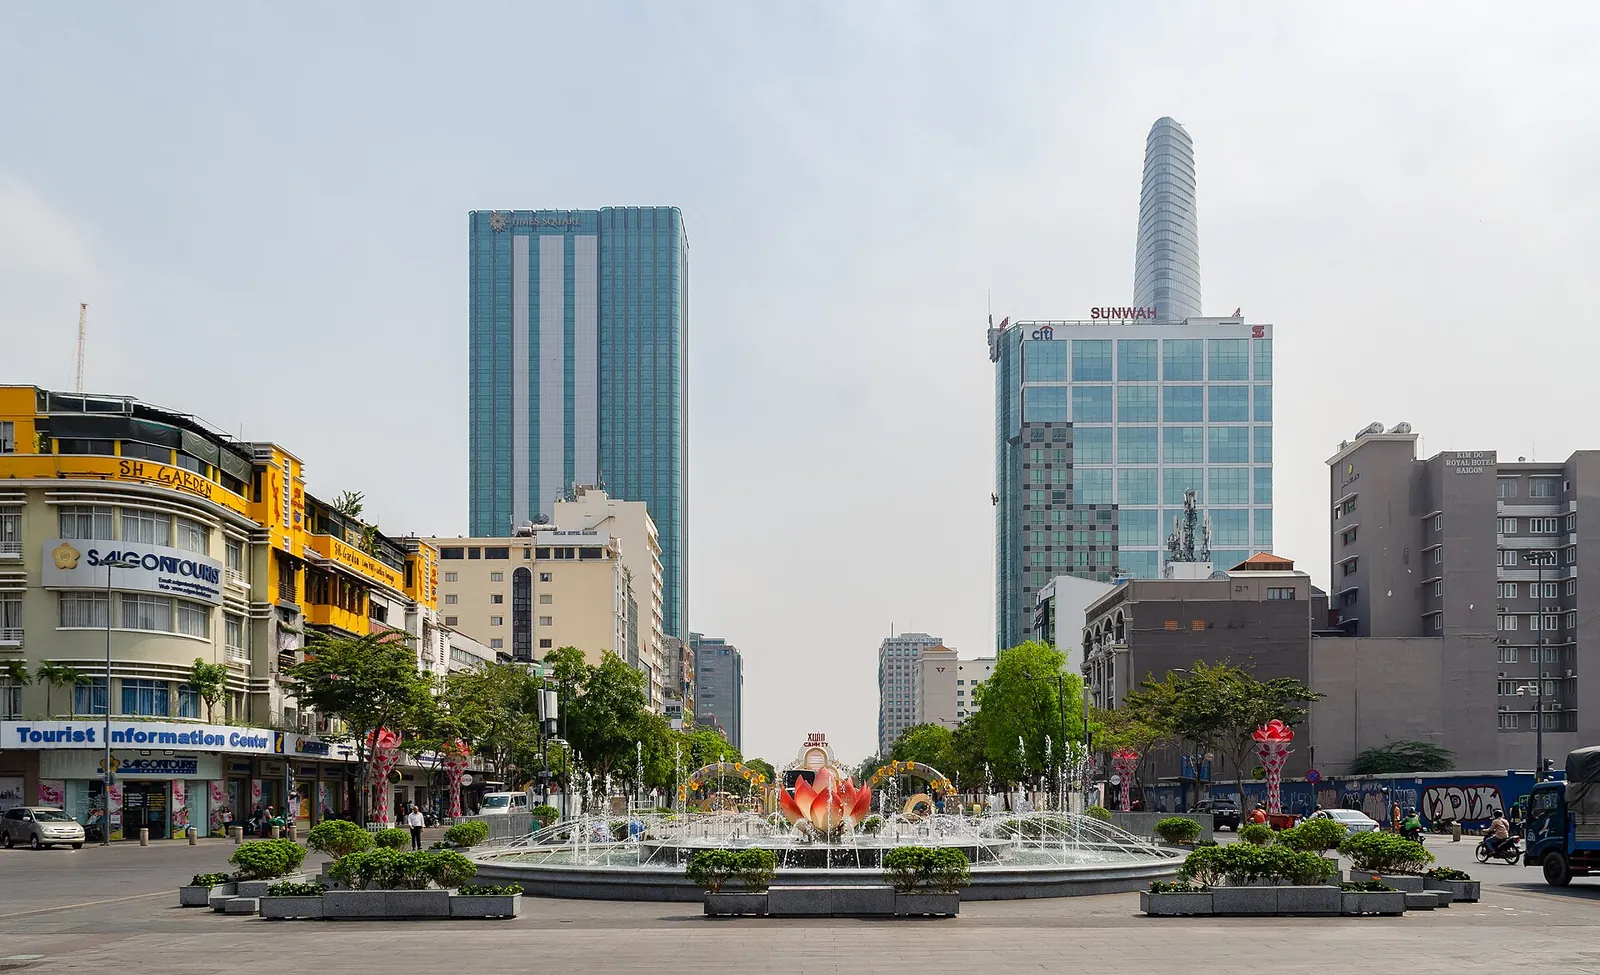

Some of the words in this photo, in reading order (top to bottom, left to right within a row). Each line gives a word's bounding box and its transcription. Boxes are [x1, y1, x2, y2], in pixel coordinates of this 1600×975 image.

[510, 217, 541, 227] TIMES
[543, 216, 581, 229] SQUARE
[1090, 306, 1157, 319] SUNWAH
[1031, 325, 1054, 341] citi
[1445, 459, 1470, 467] ROYAL
[157, 466, 212, 494] GARDEN
[87, 549, 221, 584] SAIGONTOURIST
[17, 727, 95, 743] Tourist
[229, 732, 269, 750] Center
[122, 759, 198, 769] SAIGONTOURIST
